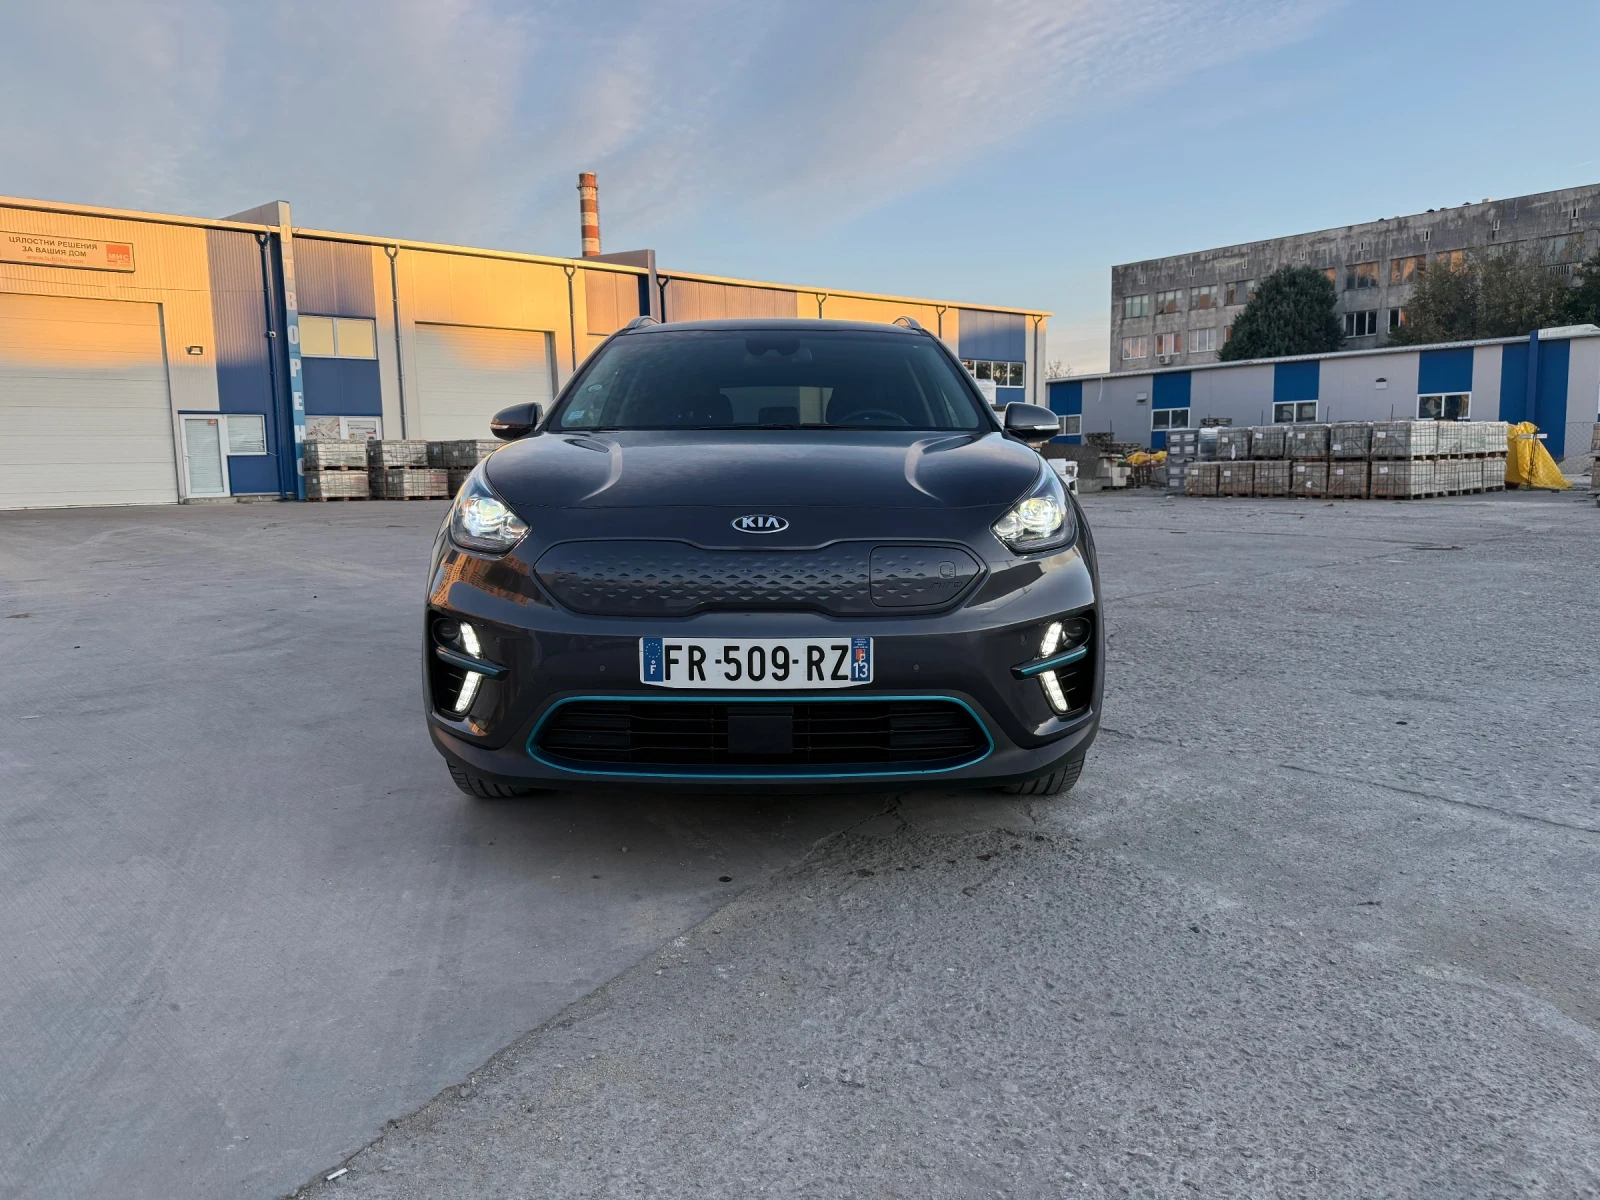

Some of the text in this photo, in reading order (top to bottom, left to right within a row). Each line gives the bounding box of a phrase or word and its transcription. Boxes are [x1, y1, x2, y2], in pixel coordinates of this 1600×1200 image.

[8, 236, 98, 250] ЦЯЛОСТНИ РЕШЕНИЯ
[22, 245, 33, 253] ЗА
[35, 247, 67, 256] ВАШИЯ
[742, 516, 780, 528] KIA
[664, 644, 849, 681] FR-509-RZ
[650, 665, 657, 675] F
[853, 661, 868, 678] 13
